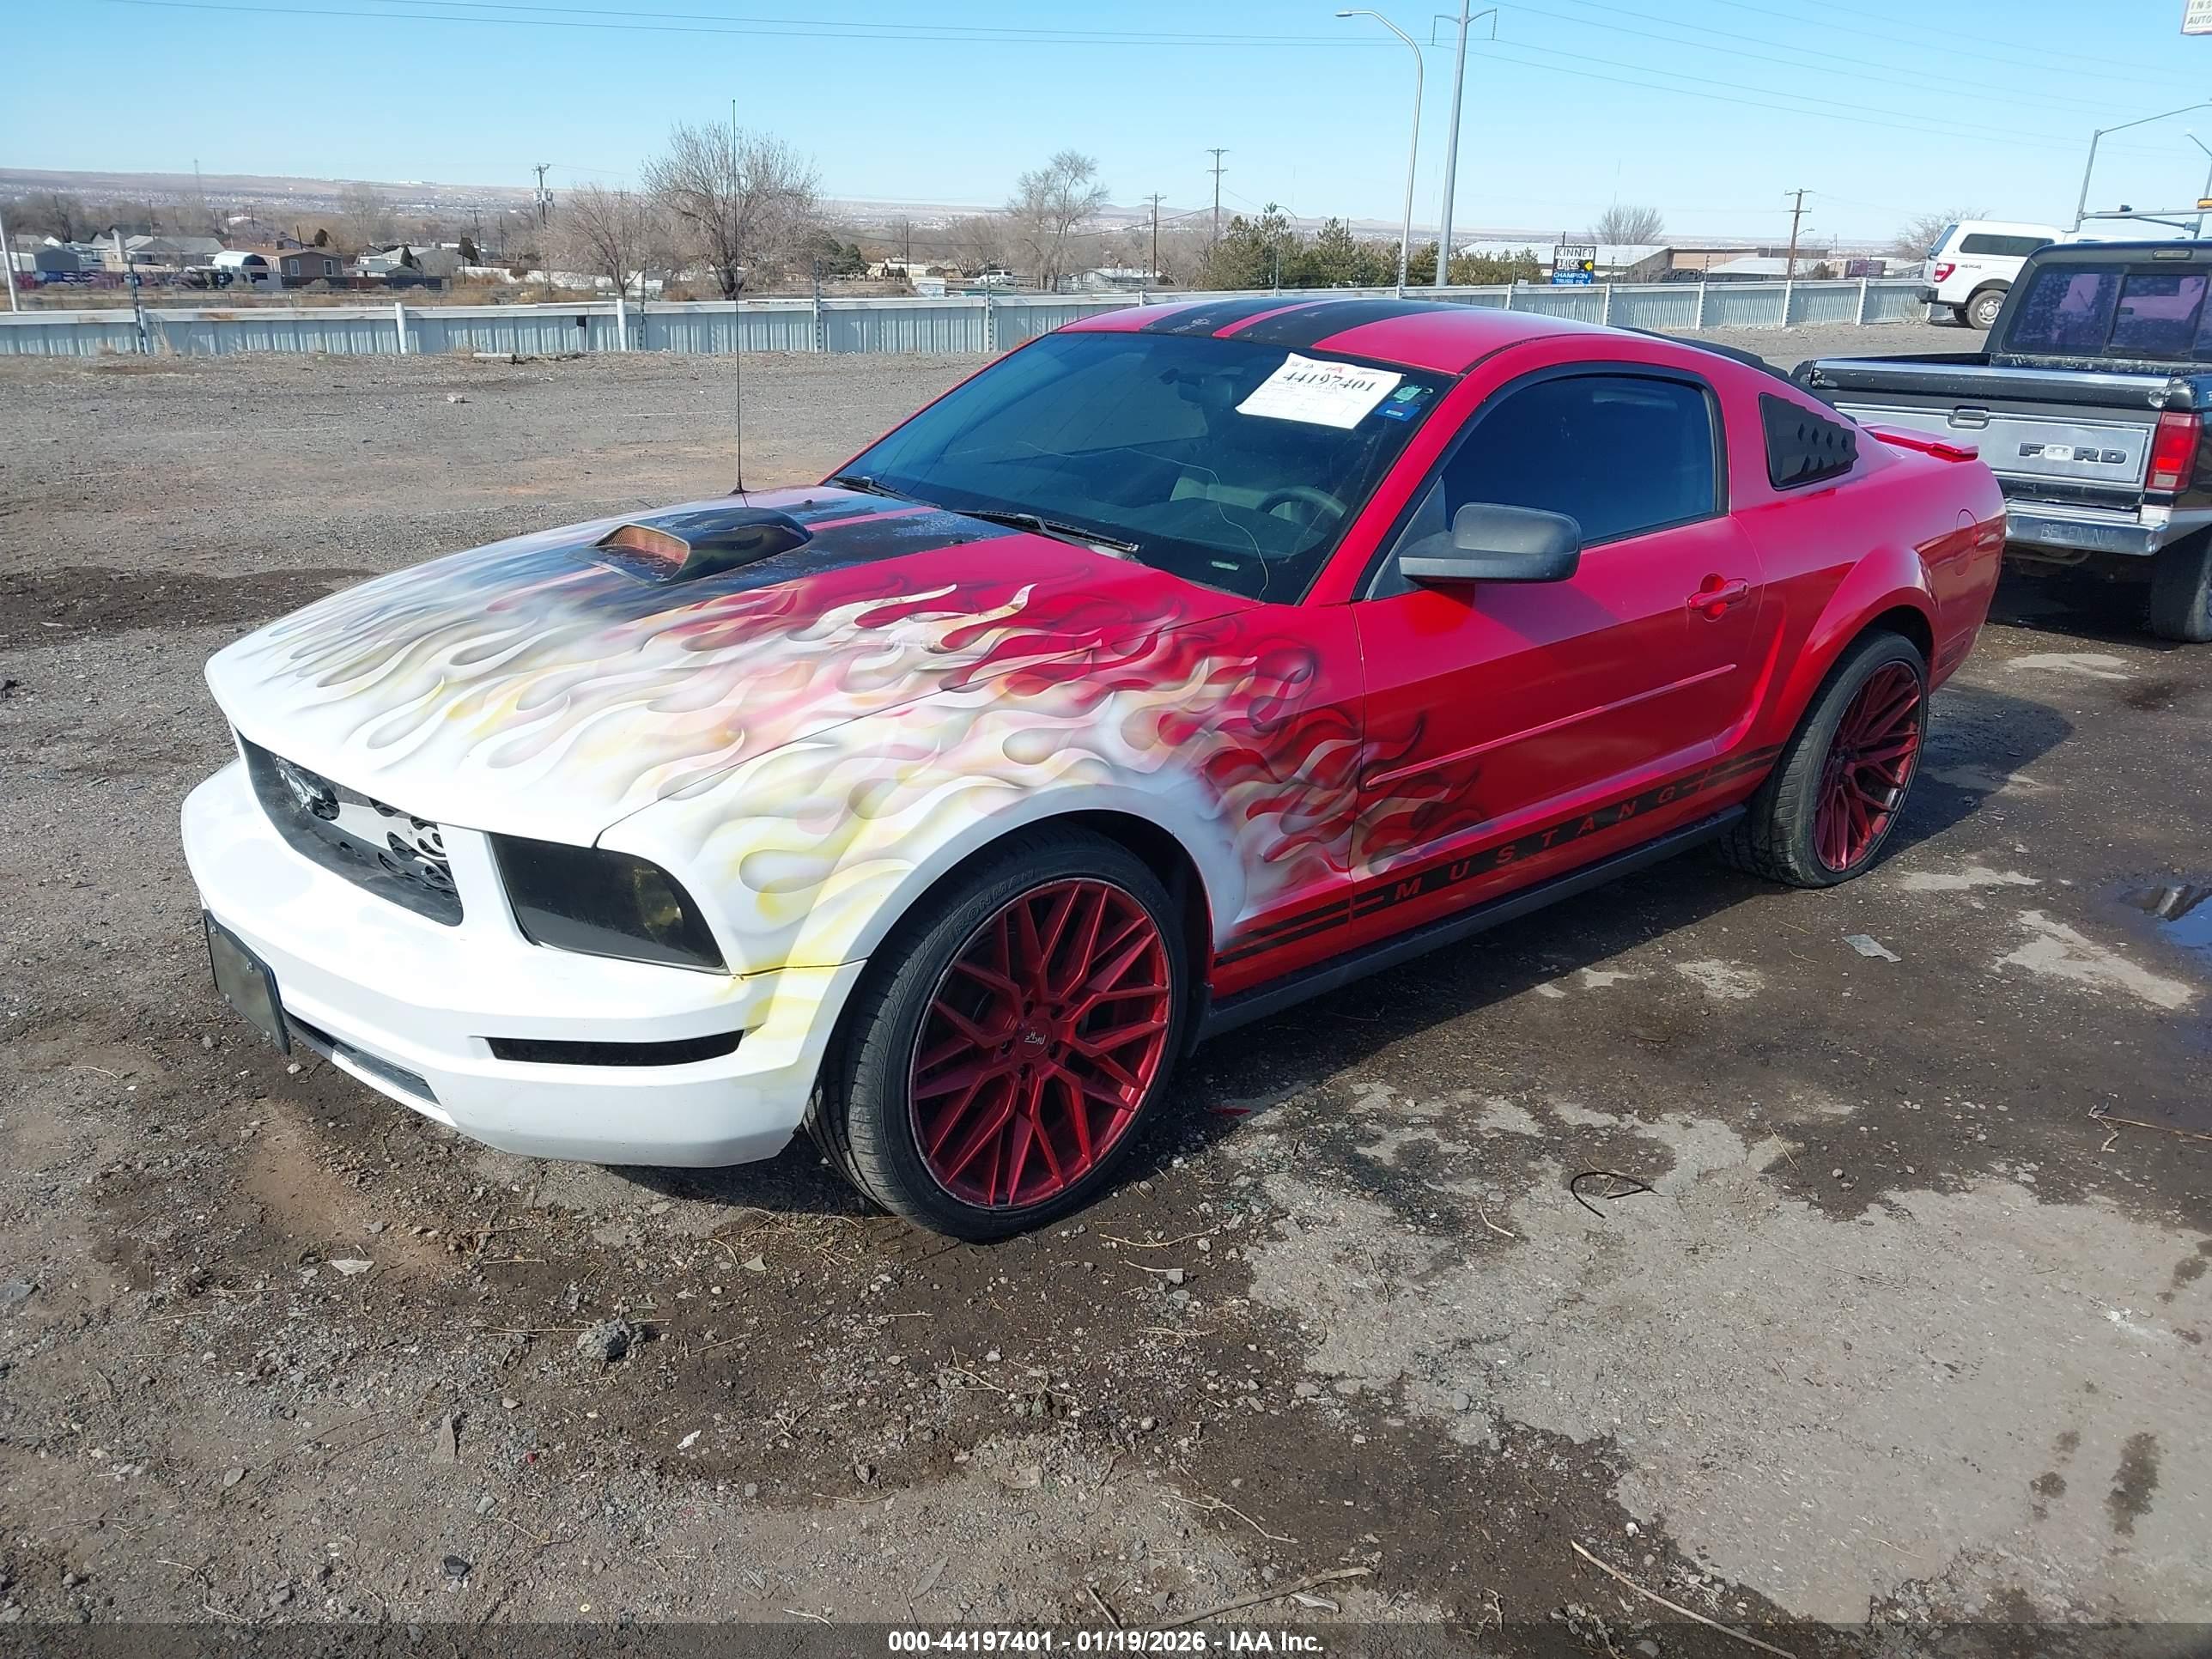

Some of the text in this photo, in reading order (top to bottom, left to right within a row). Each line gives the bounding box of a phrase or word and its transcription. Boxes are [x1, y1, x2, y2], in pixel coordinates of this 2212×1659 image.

[1556, 247, 1594, 258] KINNEY
[1557, 259, 1580, 269] BRICK
[1283, 371, 1376, 392] 44197401
[1394, 785, 1677, 902] MUSTANG
[948, 867, 1038, 943] IRONMAN
